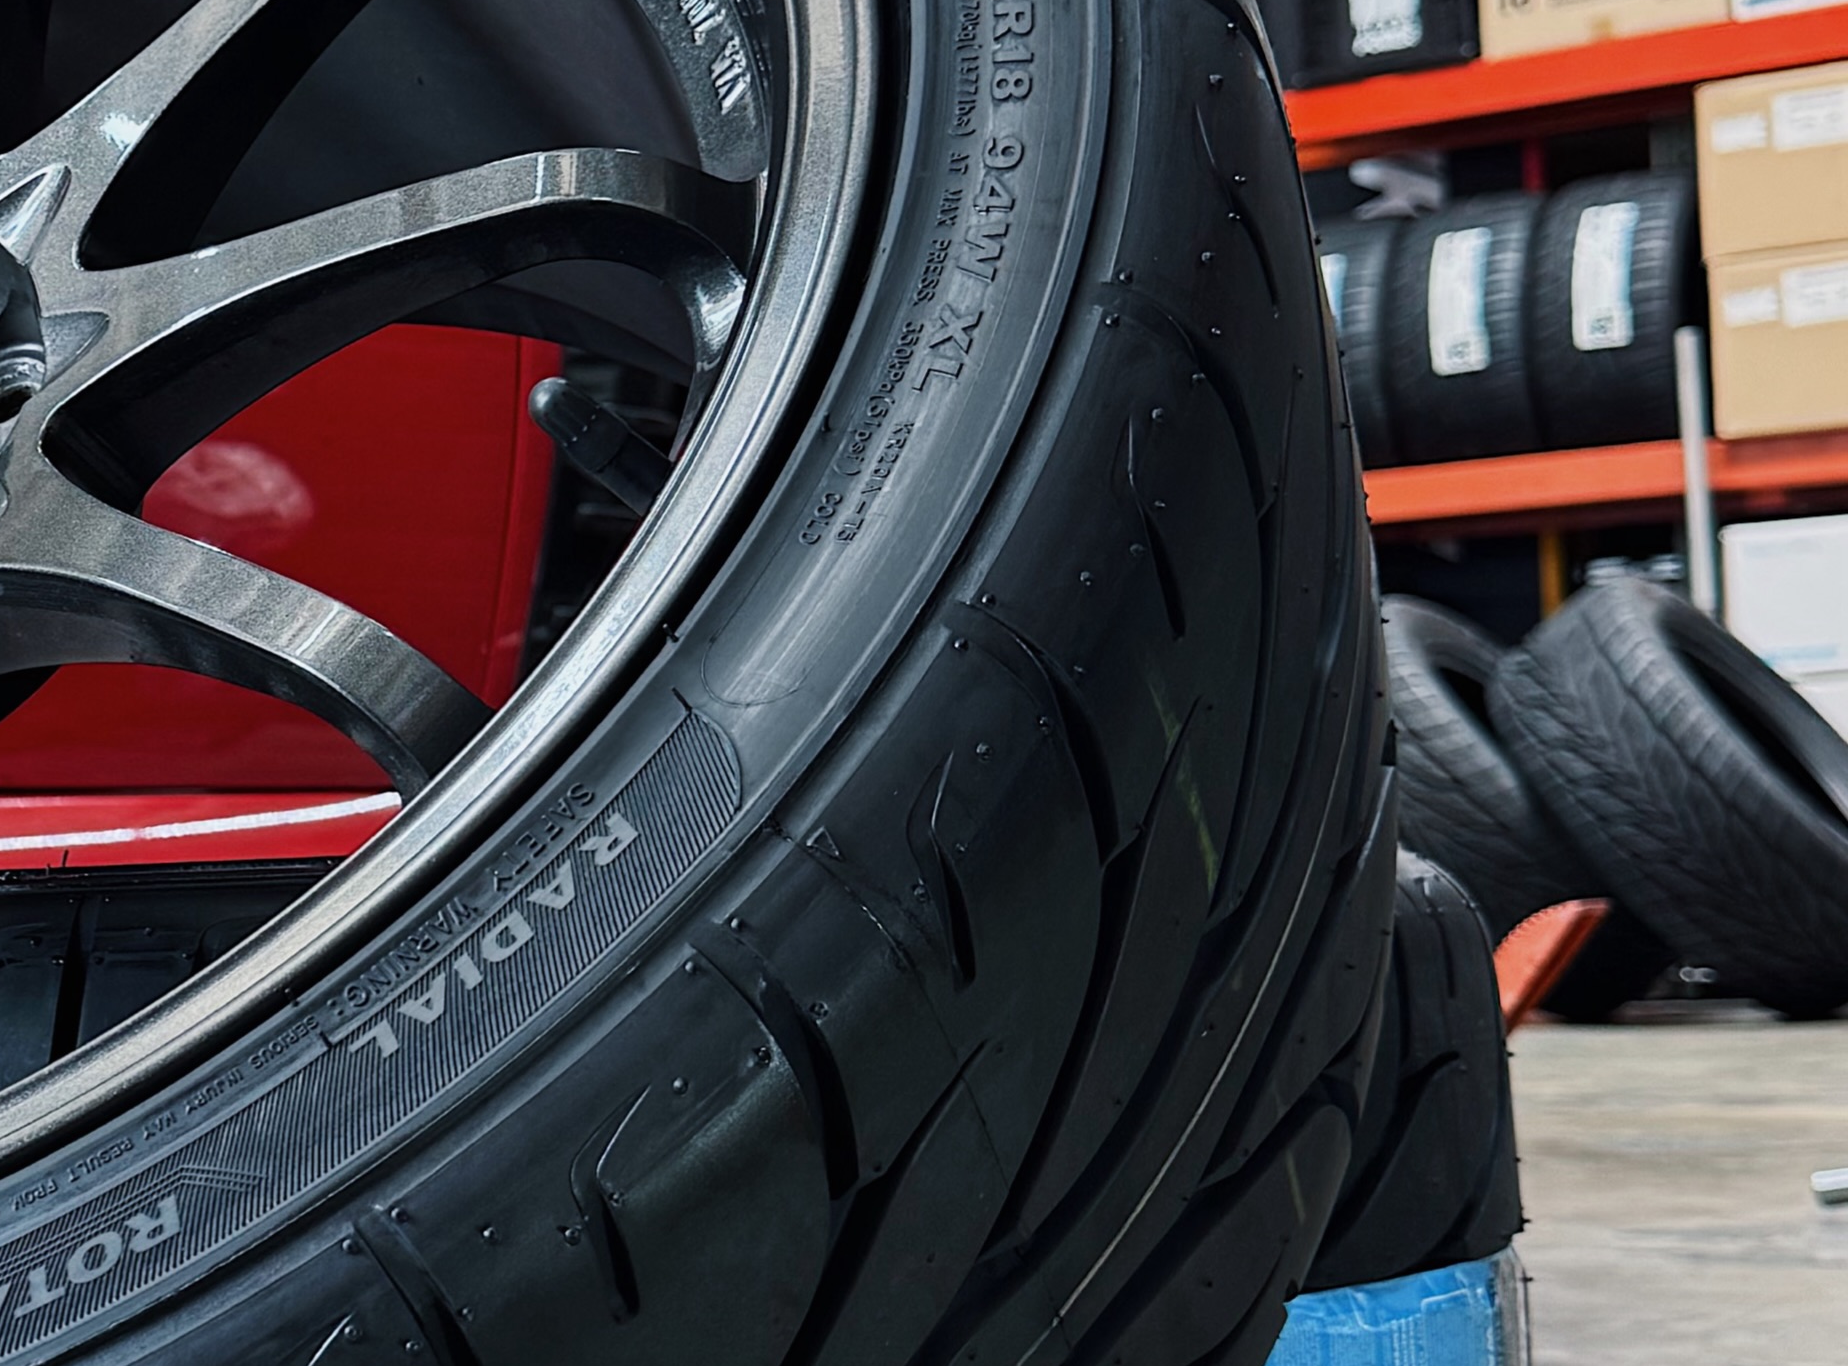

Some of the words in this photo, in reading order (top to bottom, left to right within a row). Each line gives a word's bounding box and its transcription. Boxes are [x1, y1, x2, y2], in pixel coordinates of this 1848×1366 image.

[957, 137, 1026, 283] 94W
[911, 302, 984, 393] XL
[798, 492, 842, 546] COLD
[491, 783, 597, 890] SAFETY
[327, 895, 482, 1019] WARNING:
[350, 813, 639, 1058] RADIAL
[246, 1013, 321, 1072] SERIOUS
[136, 1108, 179, 1142] MAY
[178, 1065, 246, 1116] INJURY
[63, 1133, 136, 1184] RESULT
